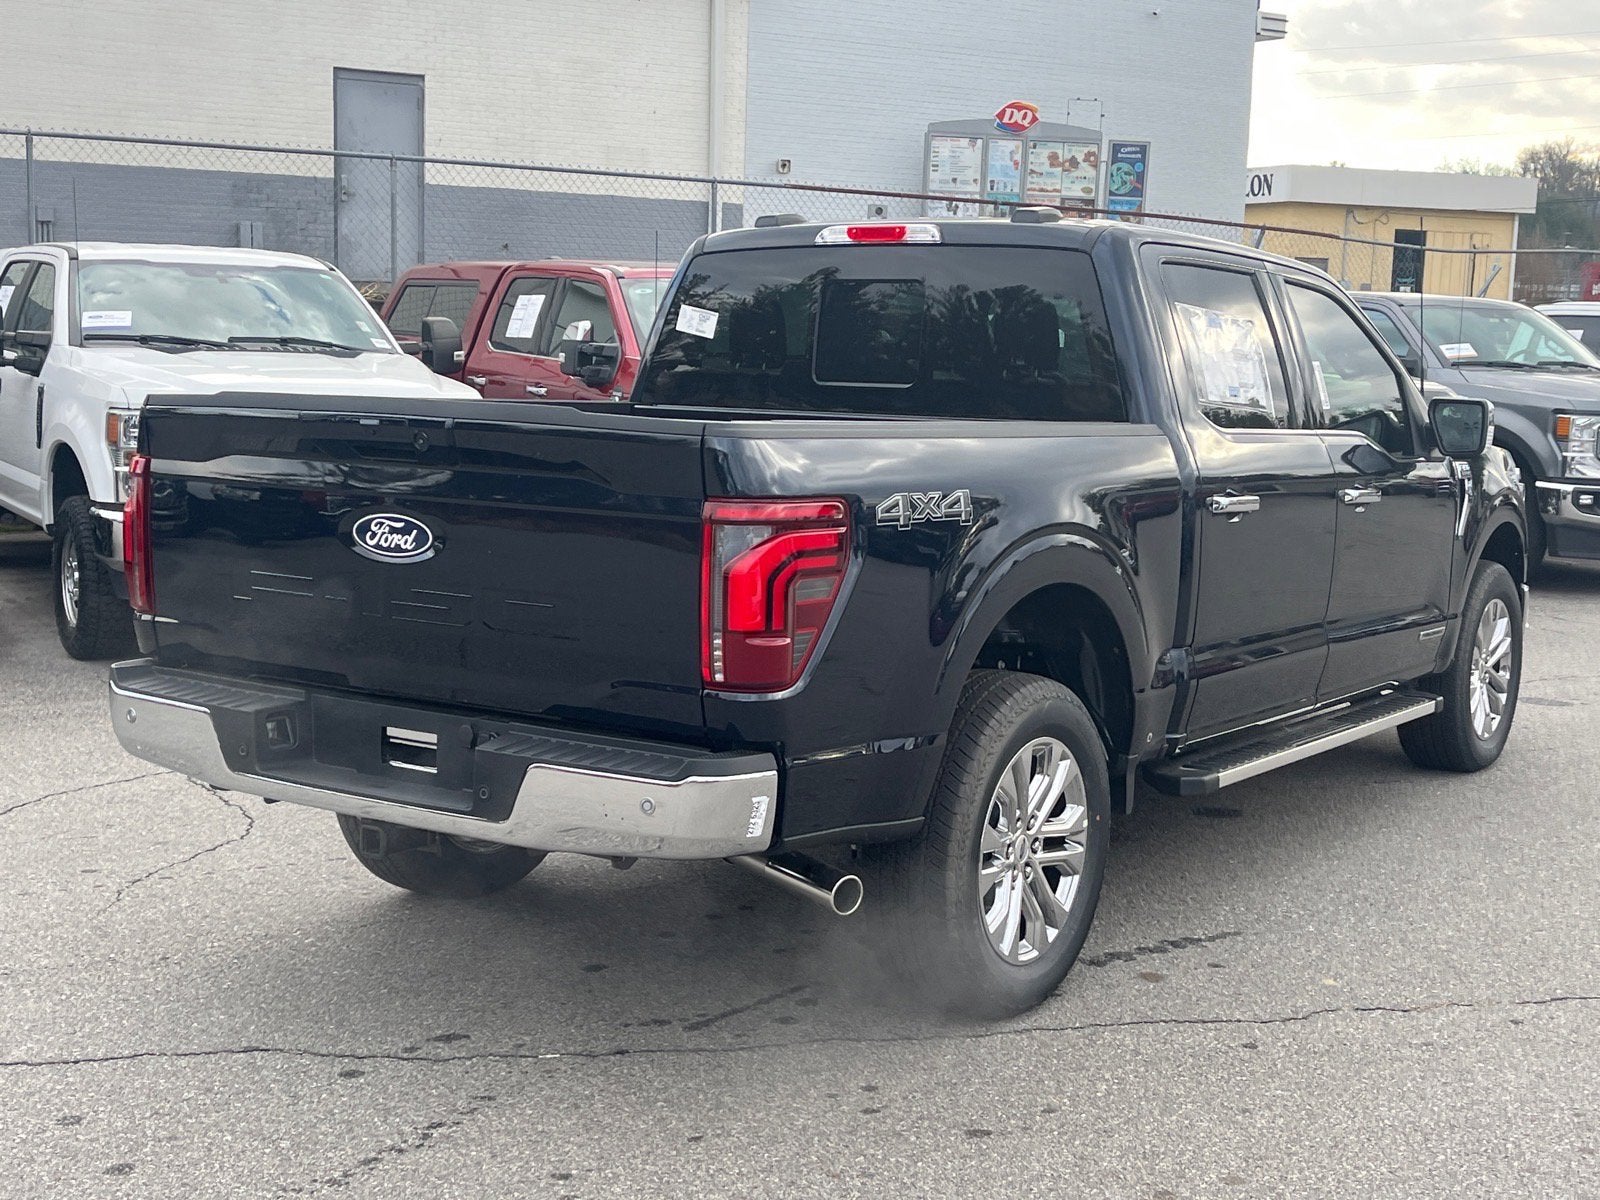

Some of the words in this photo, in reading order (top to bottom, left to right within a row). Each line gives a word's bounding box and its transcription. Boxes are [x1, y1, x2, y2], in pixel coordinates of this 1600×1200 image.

[1002, 107, 1033, 127] DQ
[1245, 173, 1274, 198] ON
[365, 518, 418, 550] Ford
